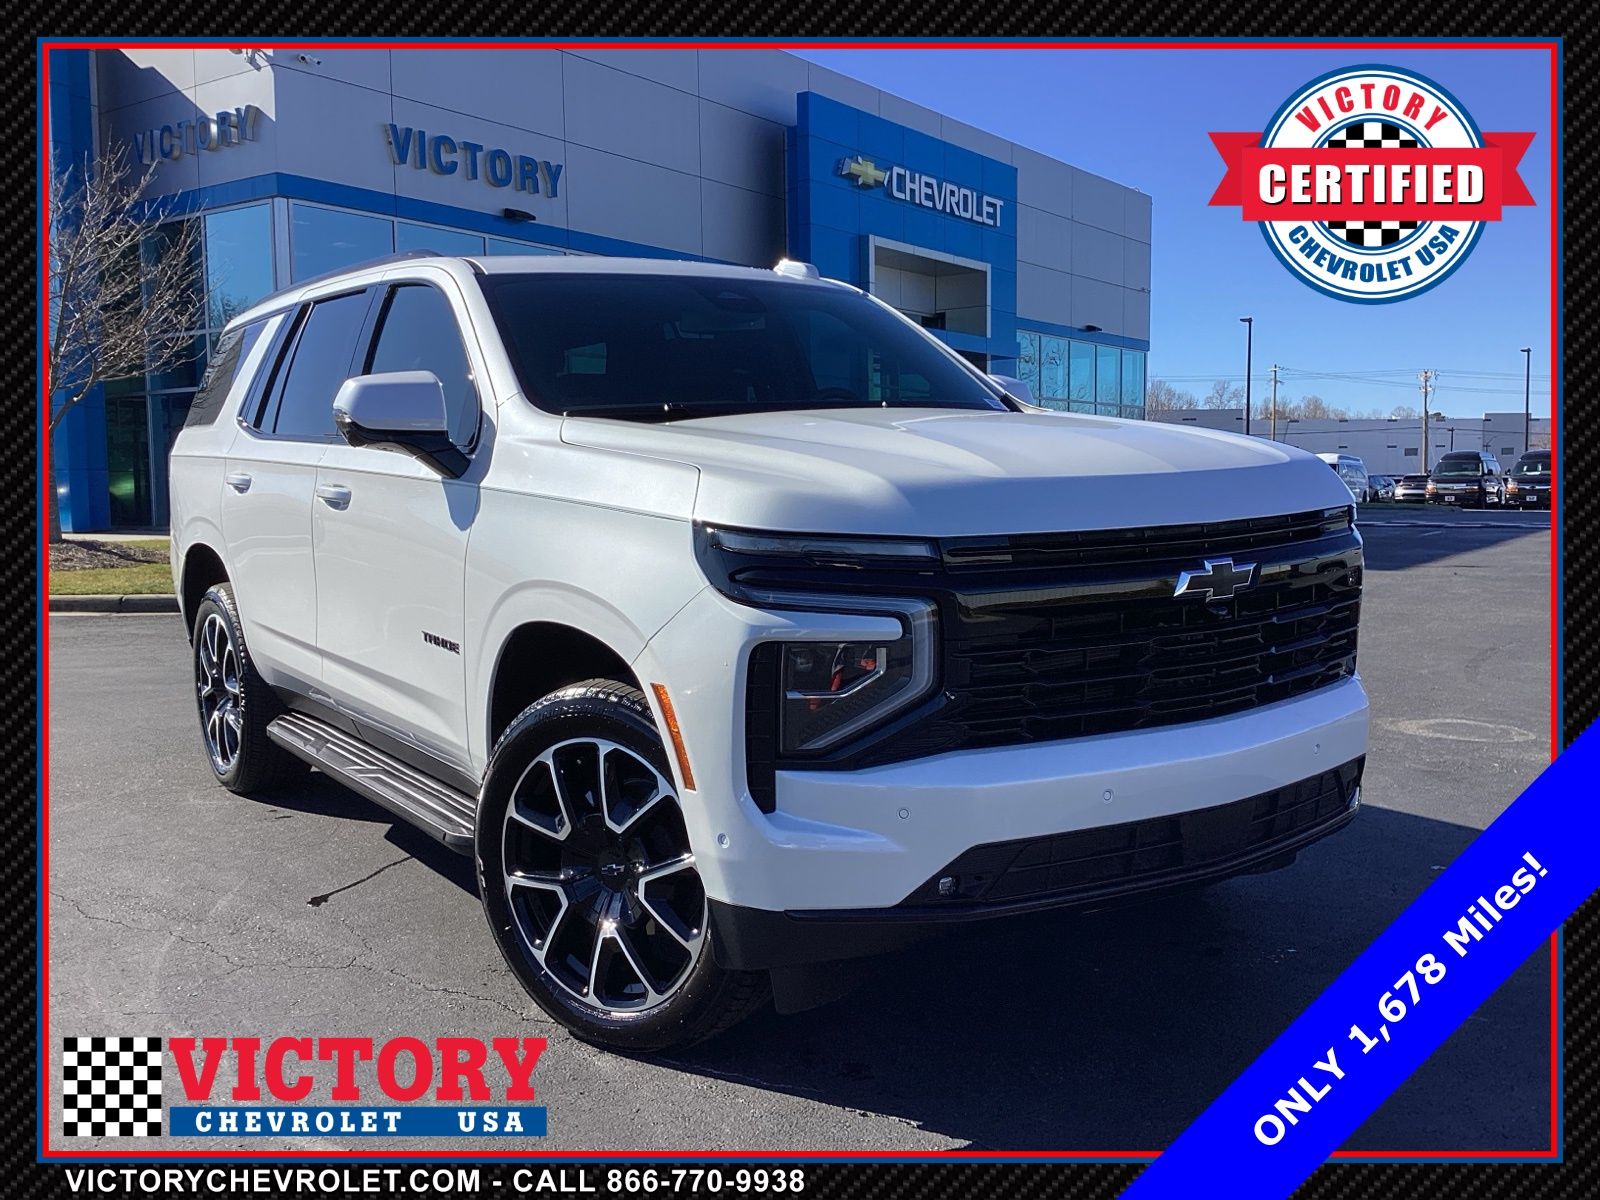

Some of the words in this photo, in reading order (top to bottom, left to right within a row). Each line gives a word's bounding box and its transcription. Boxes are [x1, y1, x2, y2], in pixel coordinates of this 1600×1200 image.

[134, 104, 257, 165] VICTORY
[386, 123, 563, 199] VICTORY
[891, 166, 1004, 228] CHEVROLET
[421, 630, 461, 655] TAHOE
